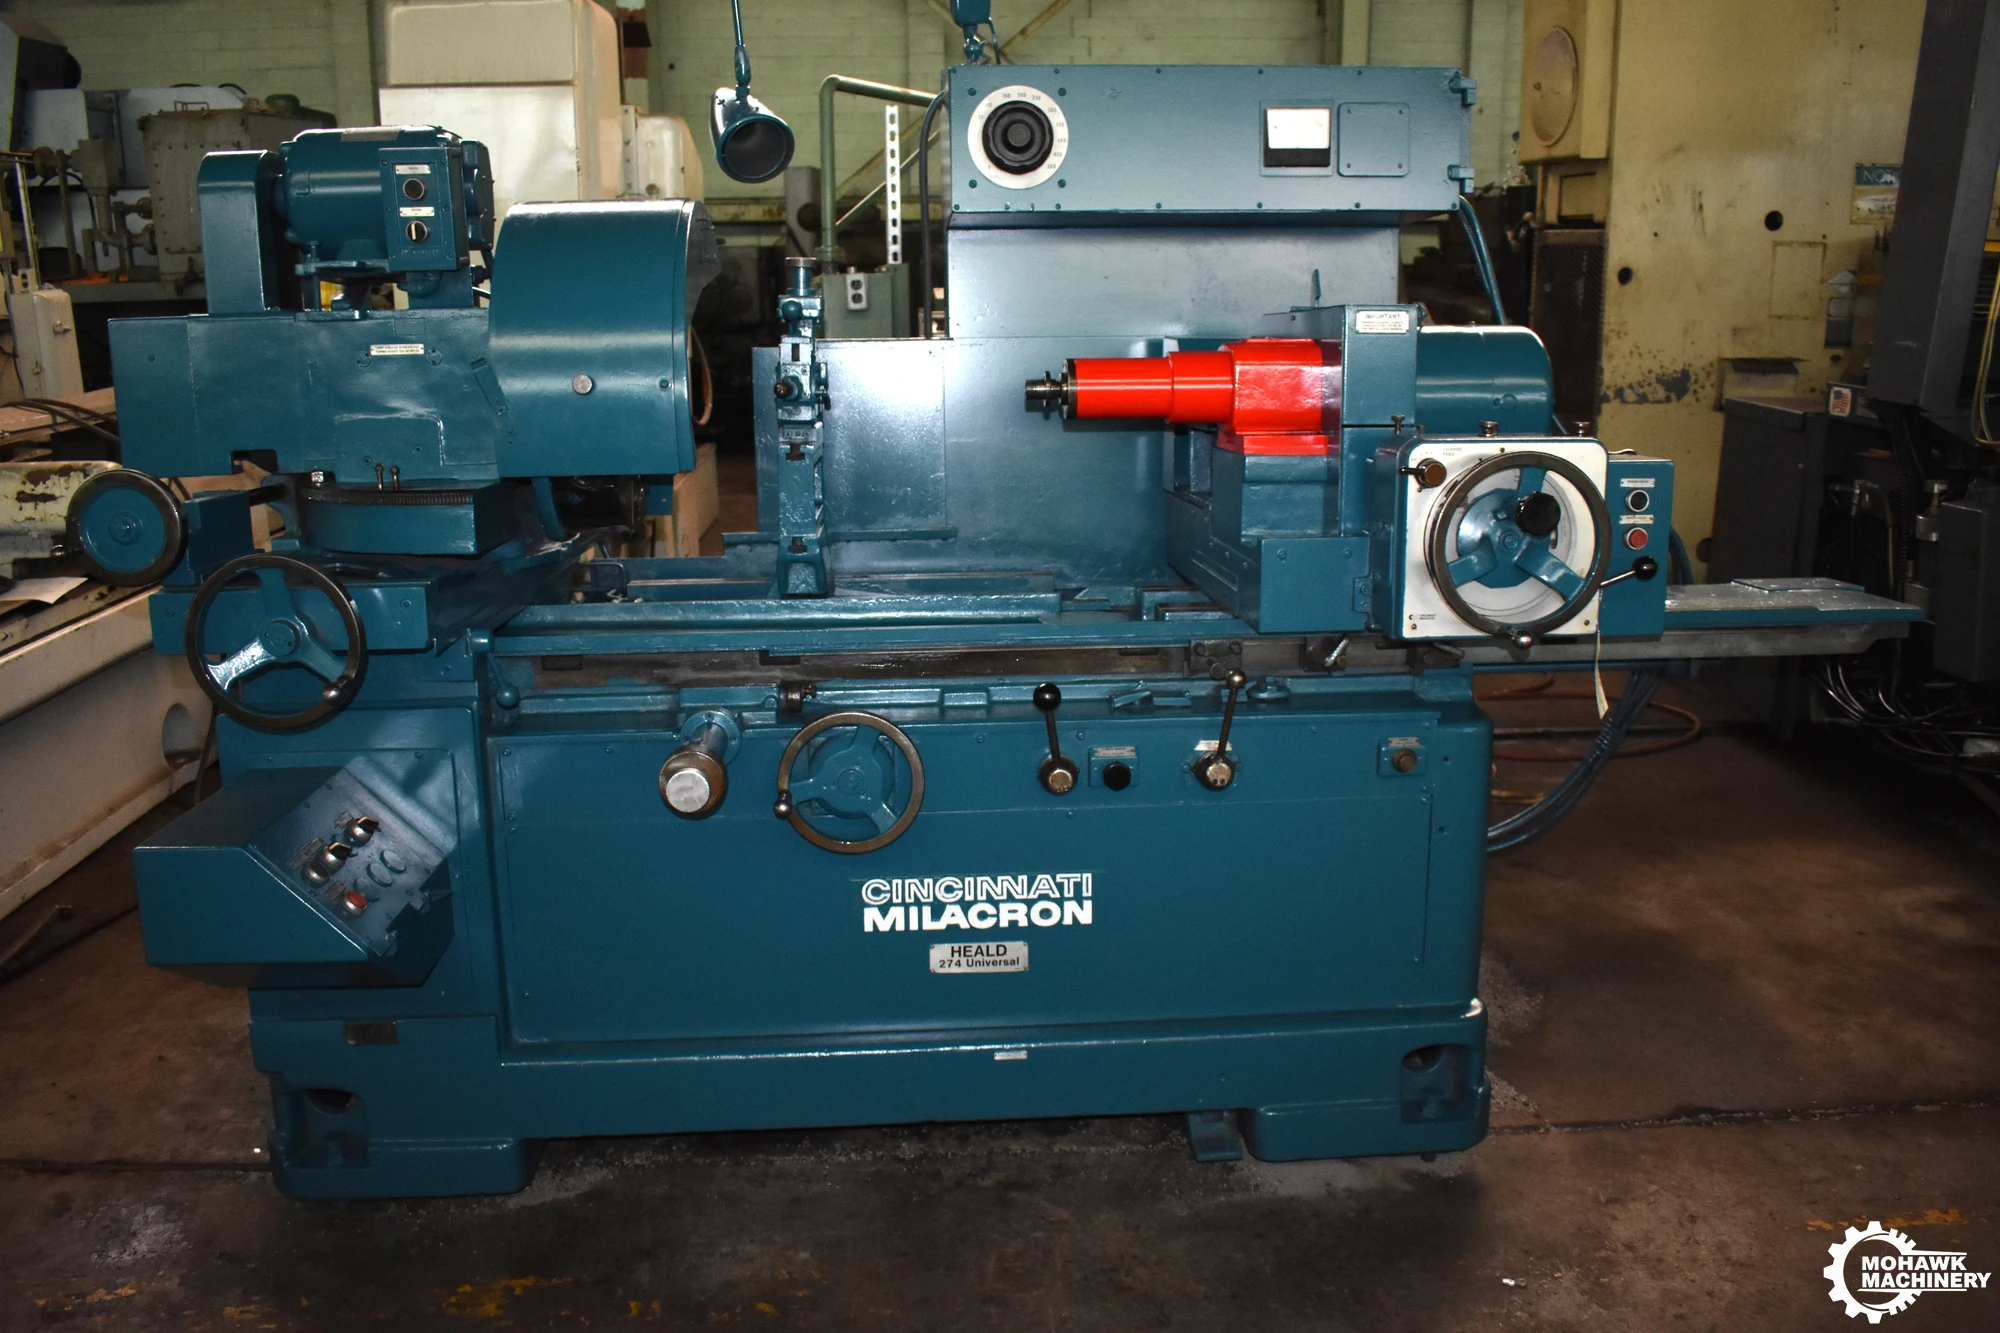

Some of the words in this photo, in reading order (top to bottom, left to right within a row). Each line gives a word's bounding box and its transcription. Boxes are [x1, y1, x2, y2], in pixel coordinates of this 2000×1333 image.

[861, 873, 1092, 906] CINCINNATI
[863, 900, 1093, 932] MILACRON
[939, 959, 962, 969] 274
[966, 957, 1020, 969] Universal
[950, 944, 1007, 959] HEALD
